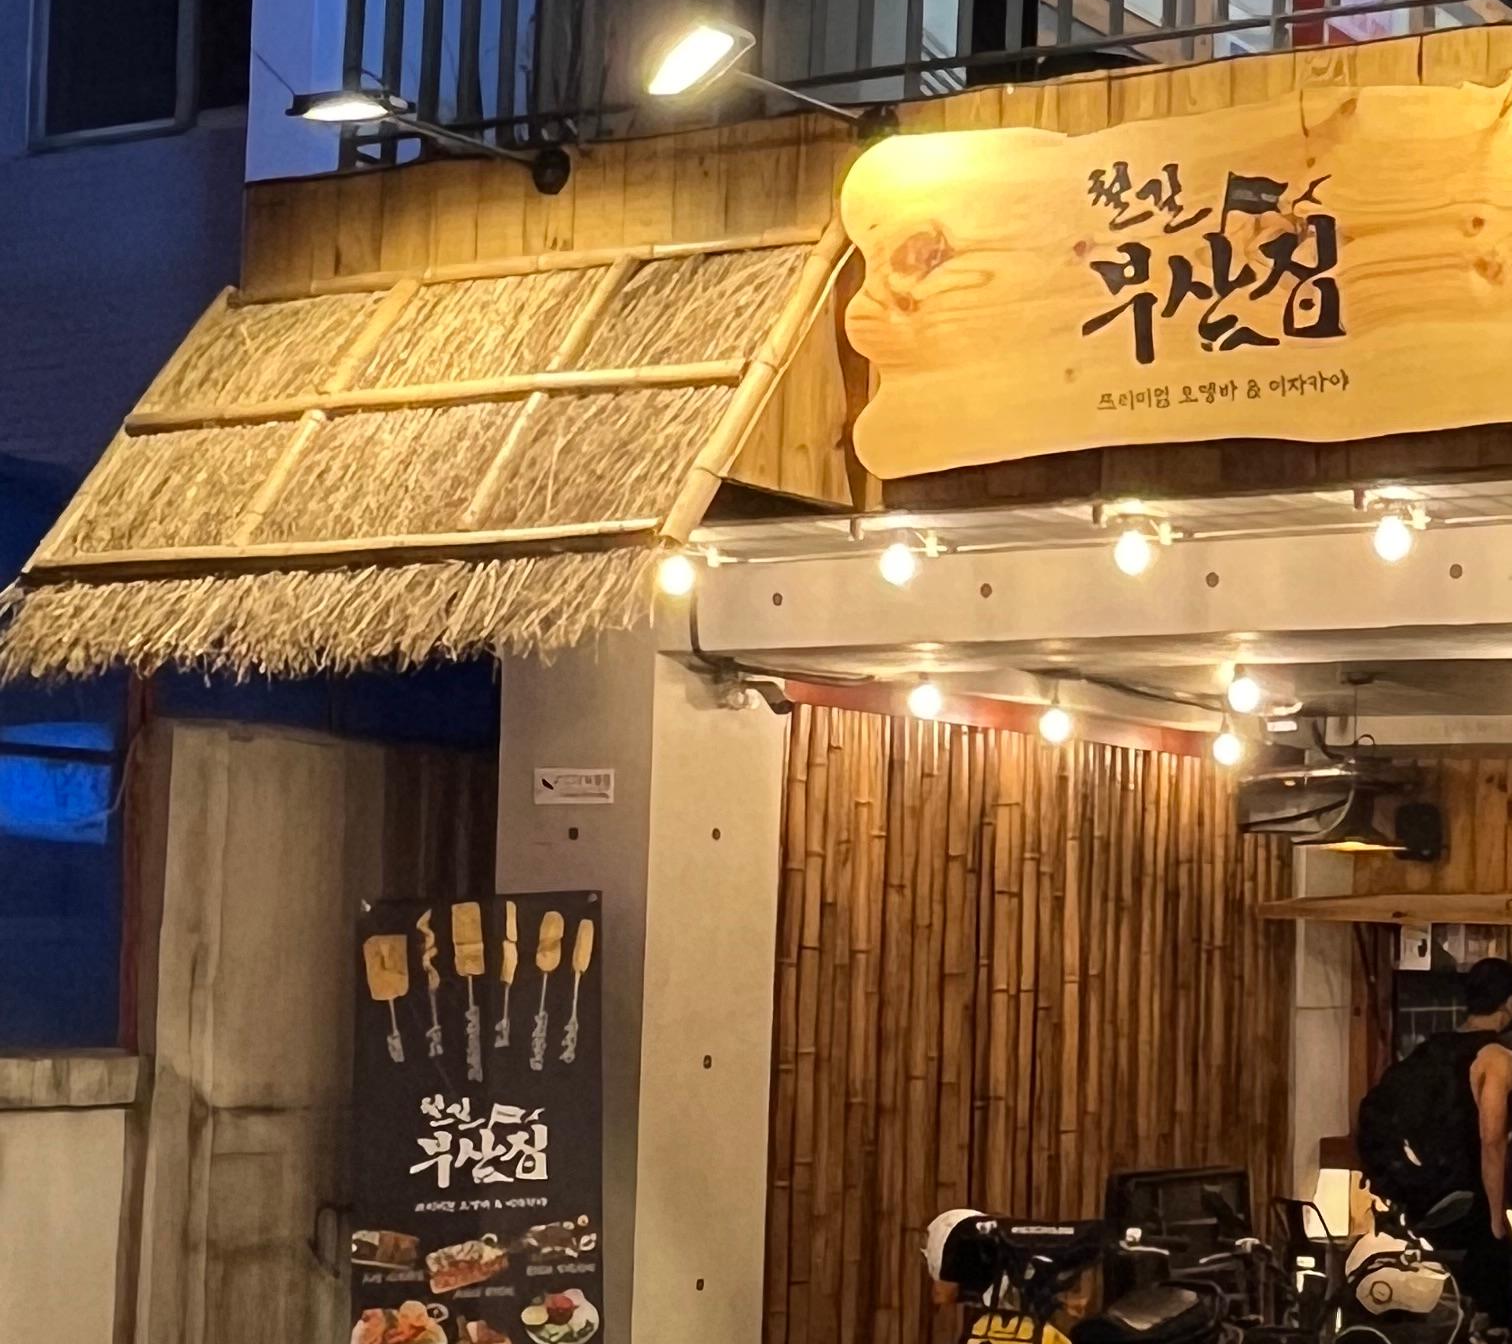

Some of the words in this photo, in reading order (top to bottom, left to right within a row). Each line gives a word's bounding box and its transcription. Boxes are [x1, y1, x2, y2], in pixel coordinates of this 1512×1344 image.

[1082, 214, 1347, 364] 부산집
[1247, 379, 1261, 399] &
[1269, 369, 1350, 397] 이자카야
[410, 1125, 548, 1188] 부산집
